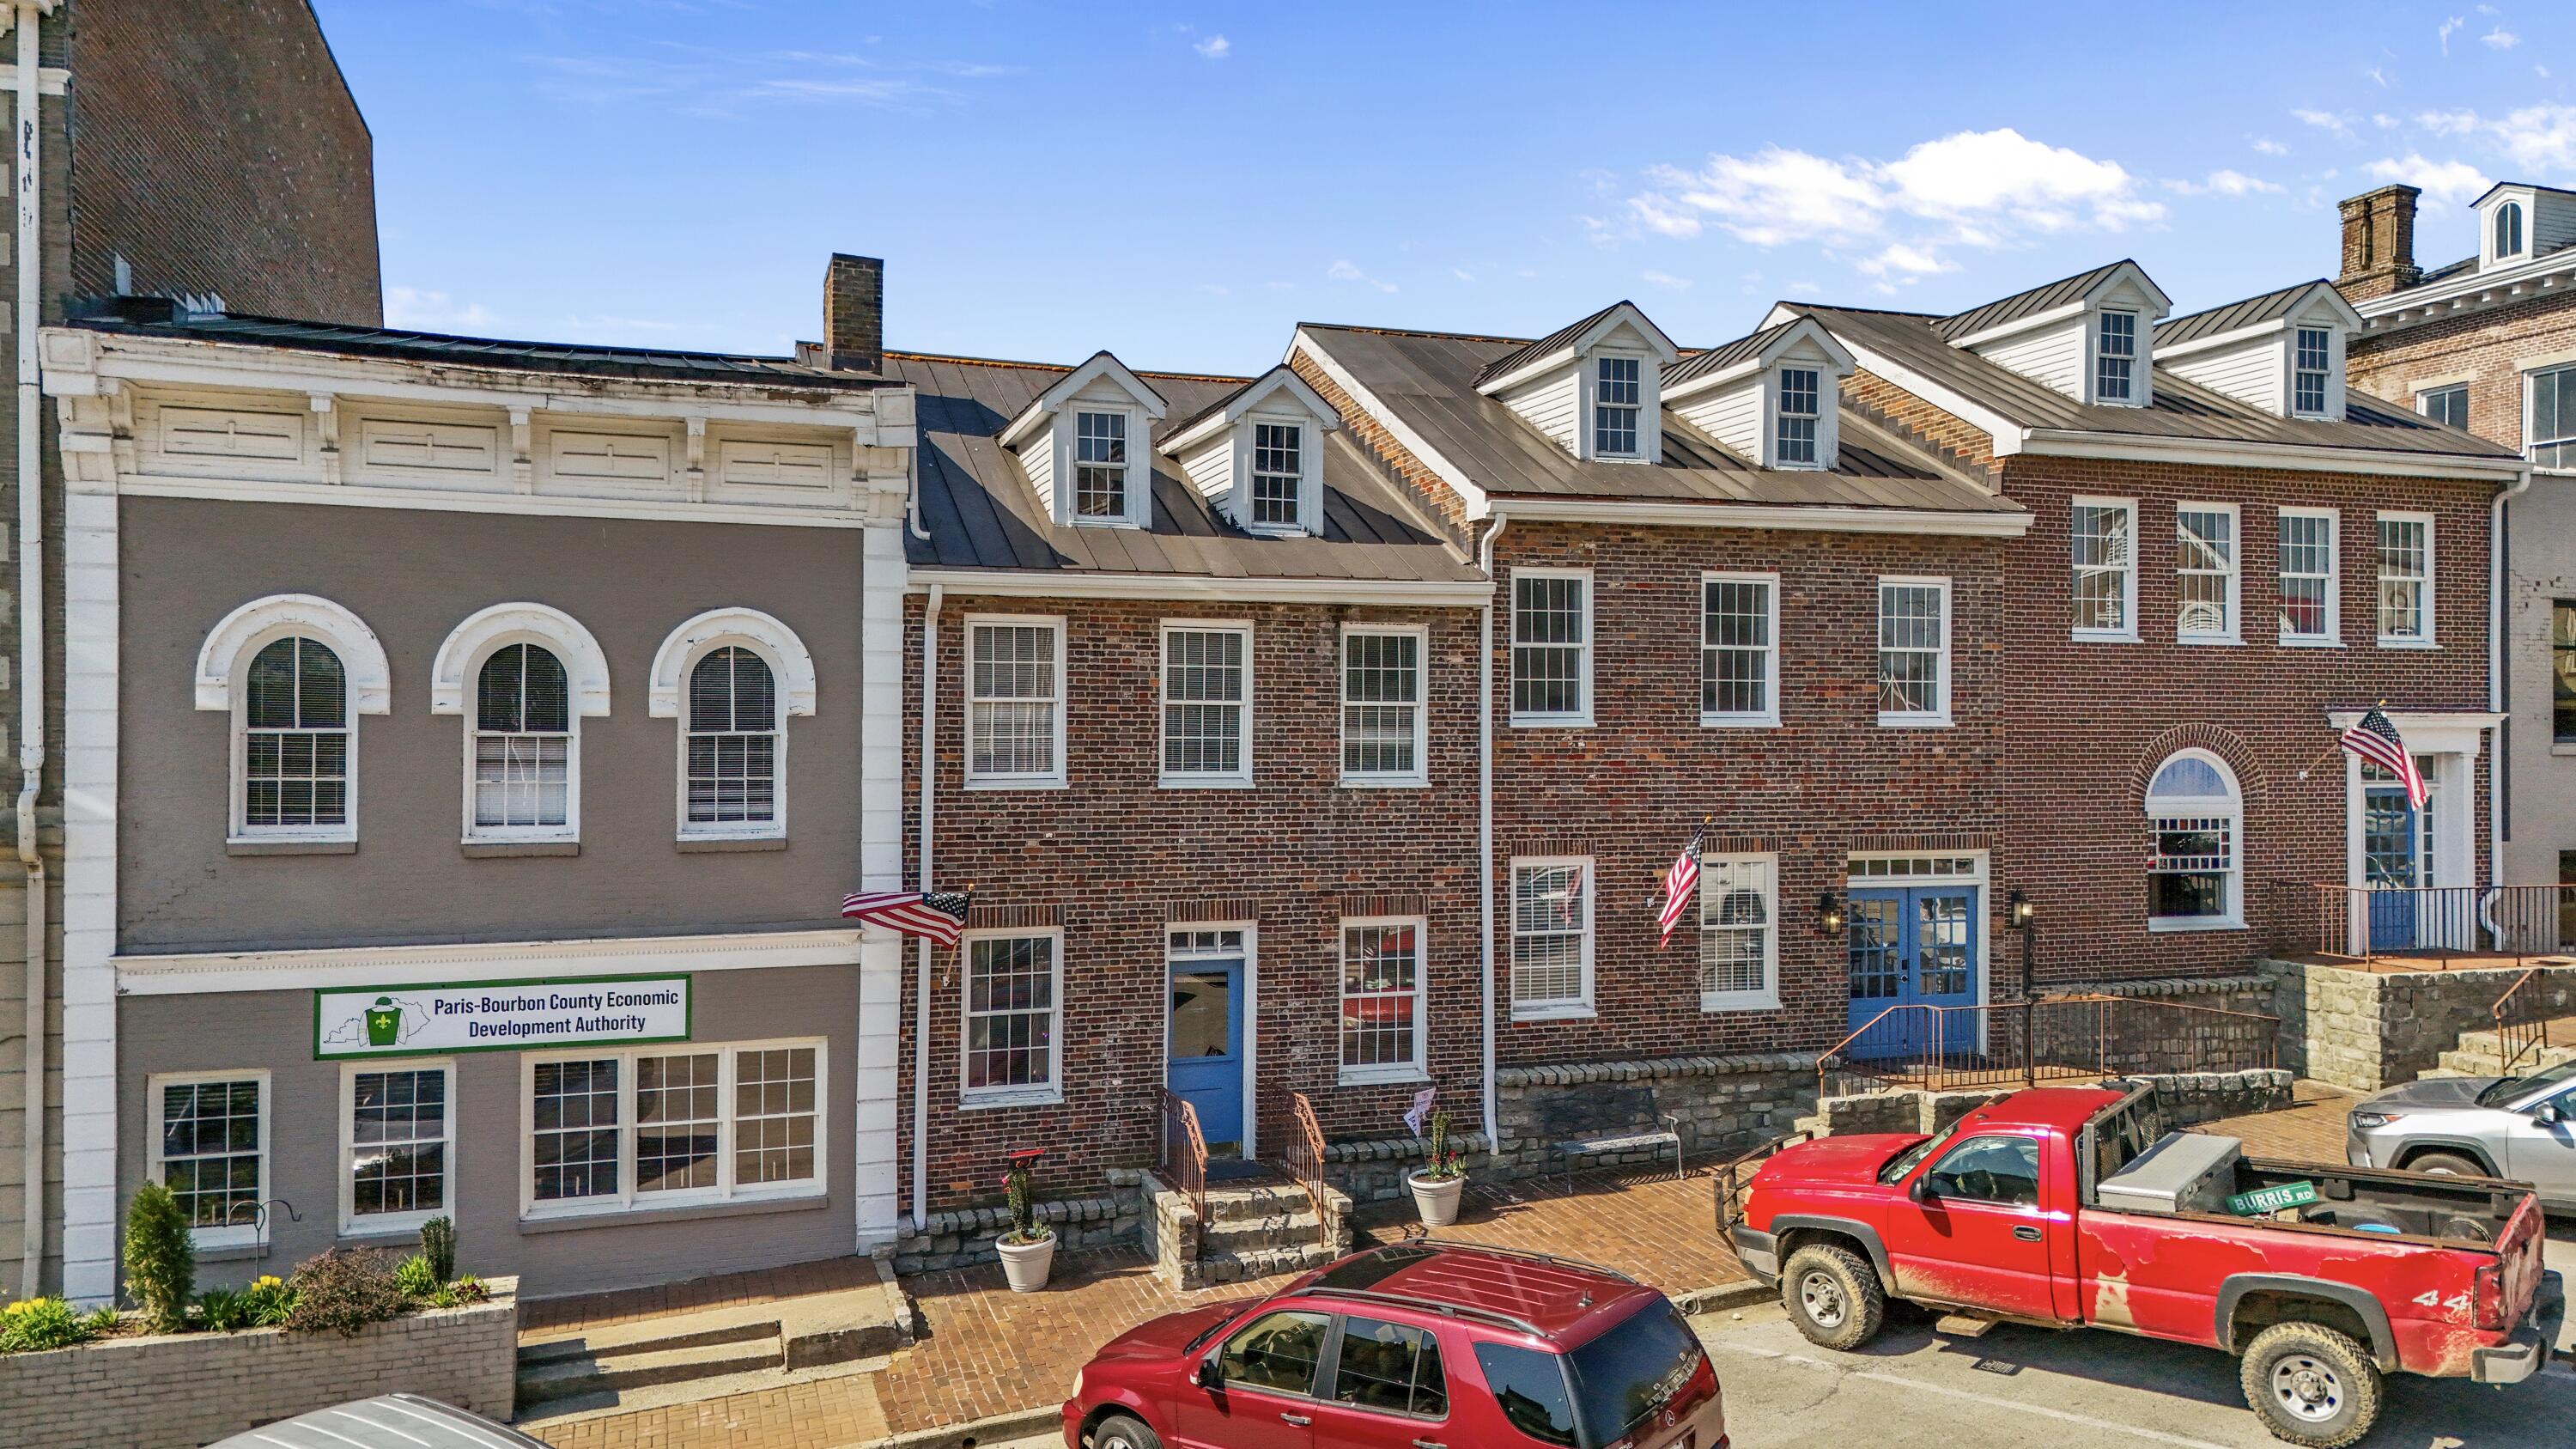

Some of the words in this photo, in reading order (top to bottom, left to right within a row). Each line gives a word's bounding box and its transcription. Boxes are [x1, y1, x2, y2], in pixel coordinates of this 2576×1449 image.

[434, 995, 545, 1015] Paris-Bourbon
[550, 993, 603, 1011] County
[606, 989, 679, 1008] Economic
[469, 1019, 571, 1038] Development
[575, 1014, 646, 1032] Authority
[2234, 1190, 2293, 1210] BURRIS
[2295, 1190, 2312, 1201] RD
